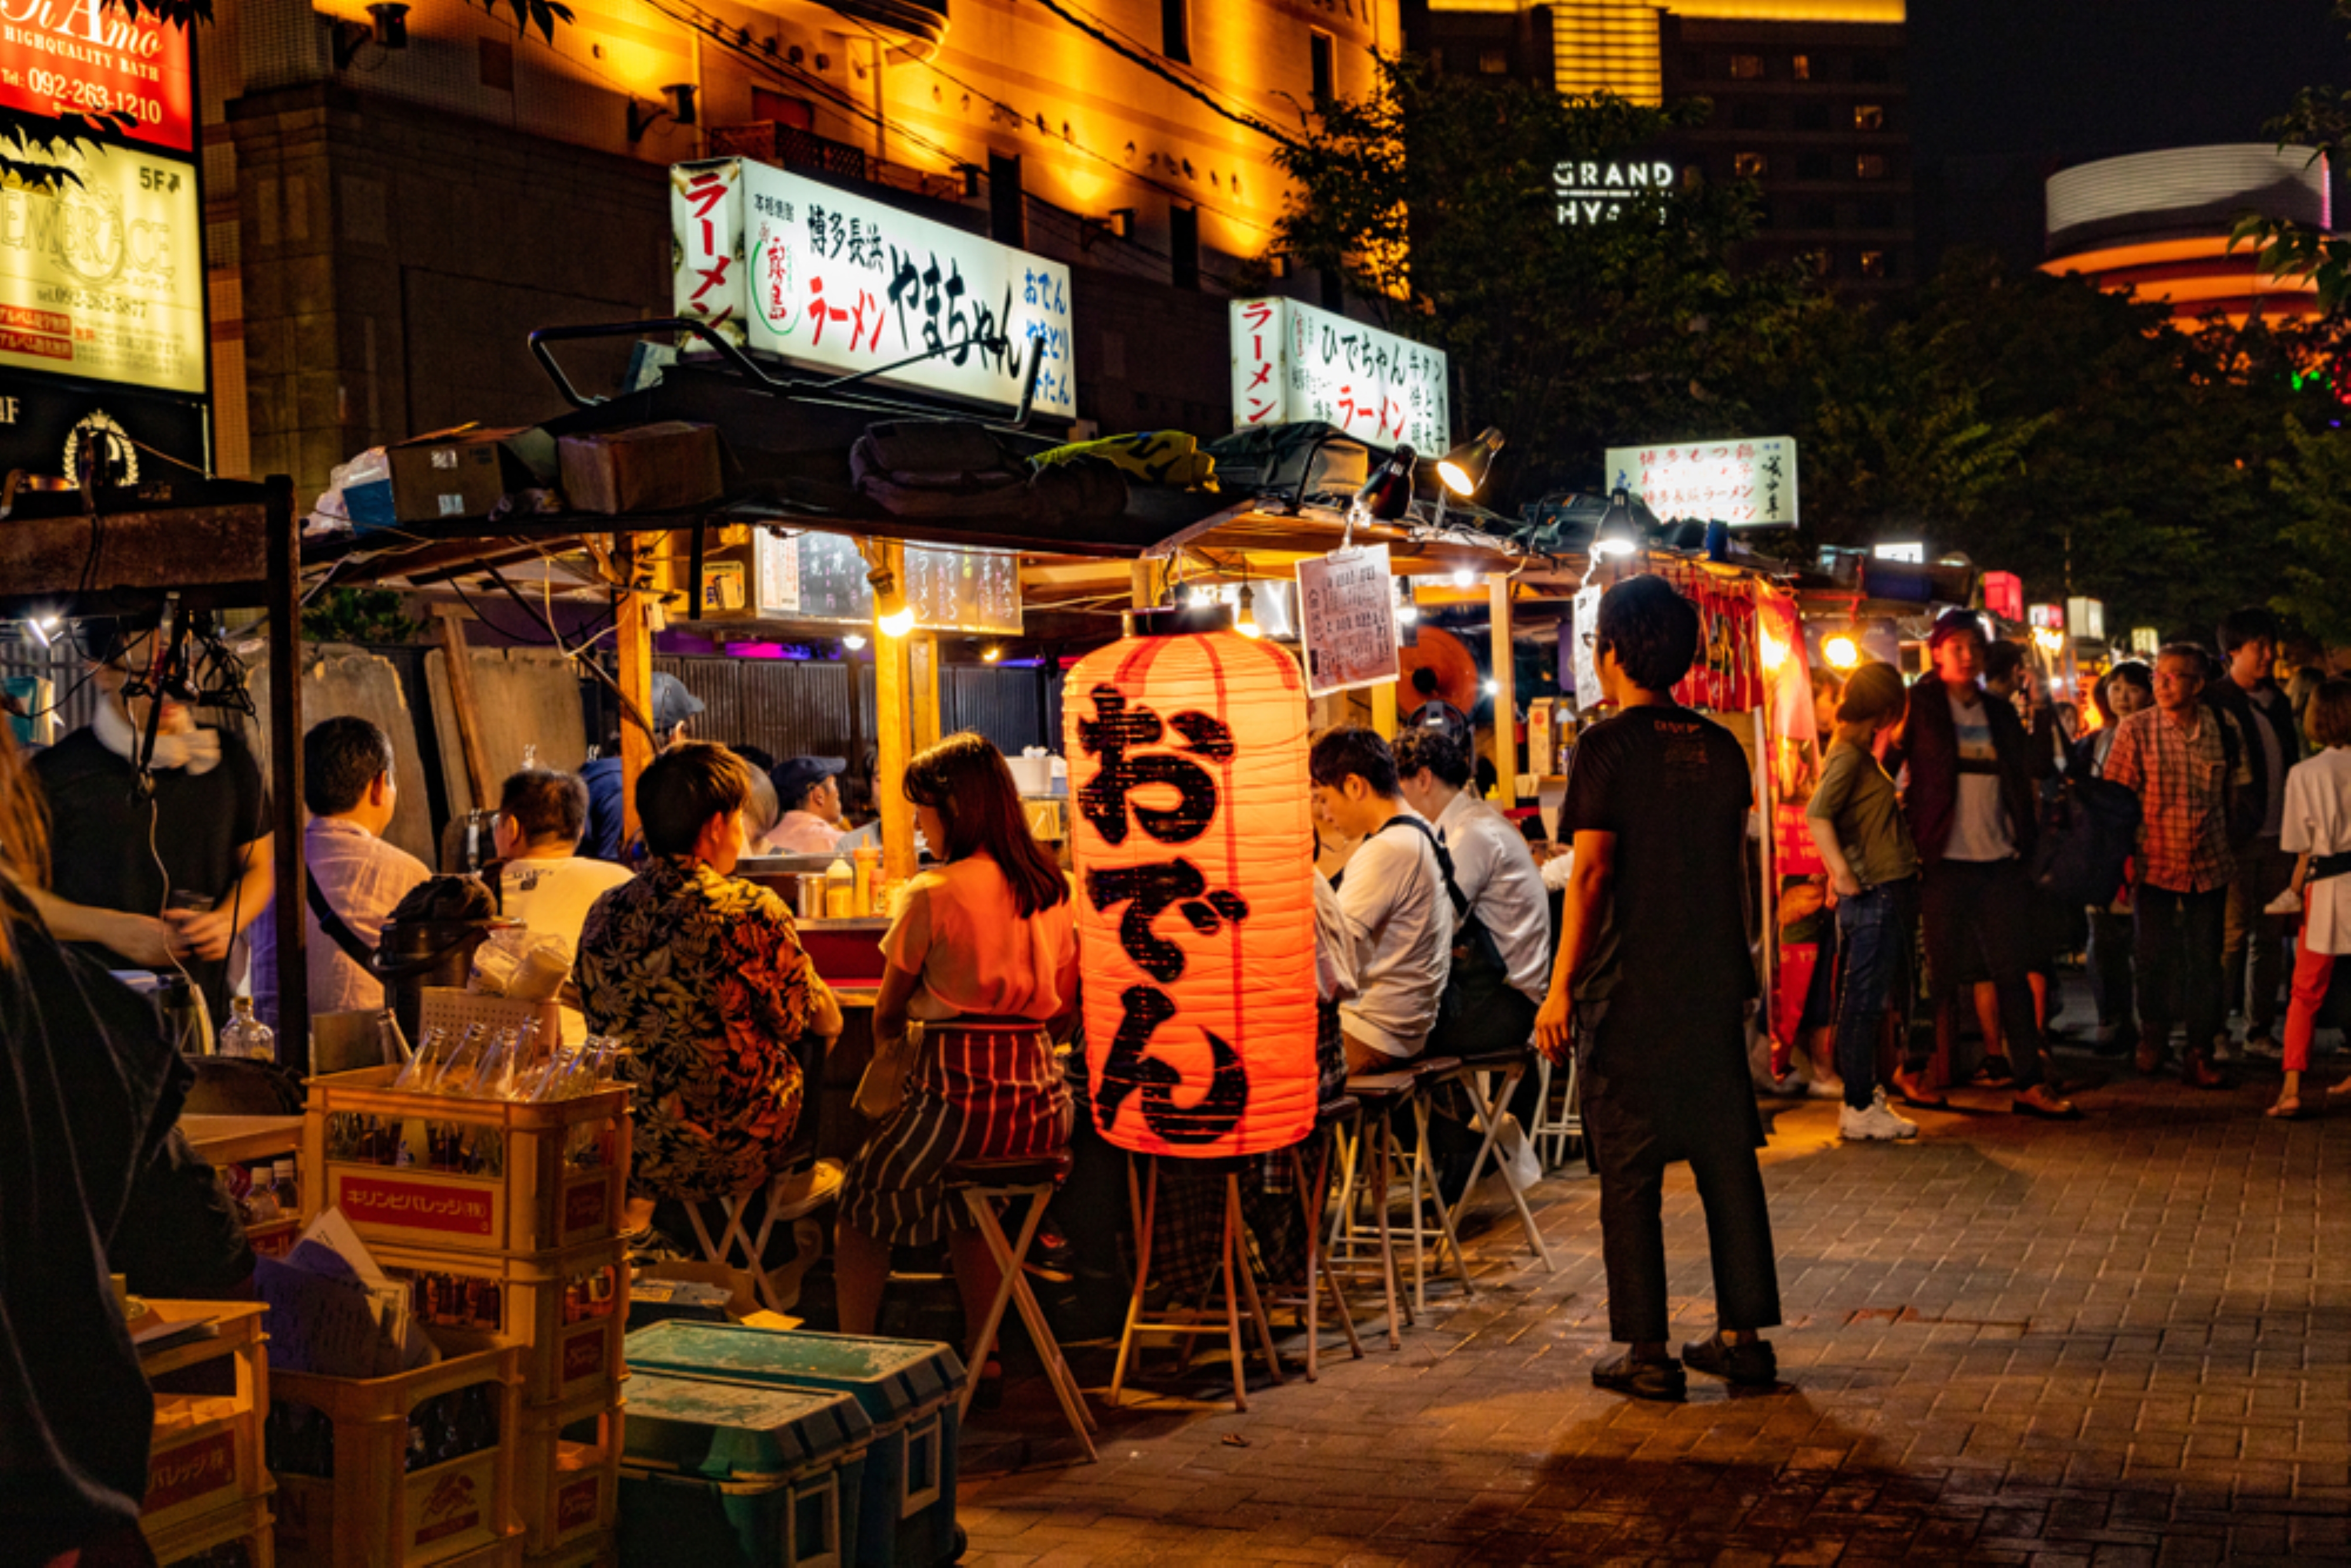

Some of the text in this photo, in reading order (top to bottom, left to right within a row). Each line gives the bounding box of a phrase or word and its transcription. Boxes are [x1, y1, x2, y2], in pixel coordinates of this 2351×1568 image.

[4, 25, 160, 83] HIGHQUALITY BATH
[28, 67, 162, 125] 092-263-1210
[139, 166, 165, 193] 5F
[1552, 160, 1674, 187] GRAND
[685, 172, 733, 340] ラーメン
[808, 203, 884, 275] 博多長浜
[808, 276, 886, 354] ラーメン
[888, 243, 1023, 379] やまちゃん
[1241, 301, 1278, 424] ラーメン
[1321, 323, 1406, 386] ひでちゃん
[1338, 384, 1406, 441] ラーメン
[1077, 683, 1250, 1145] おでん
